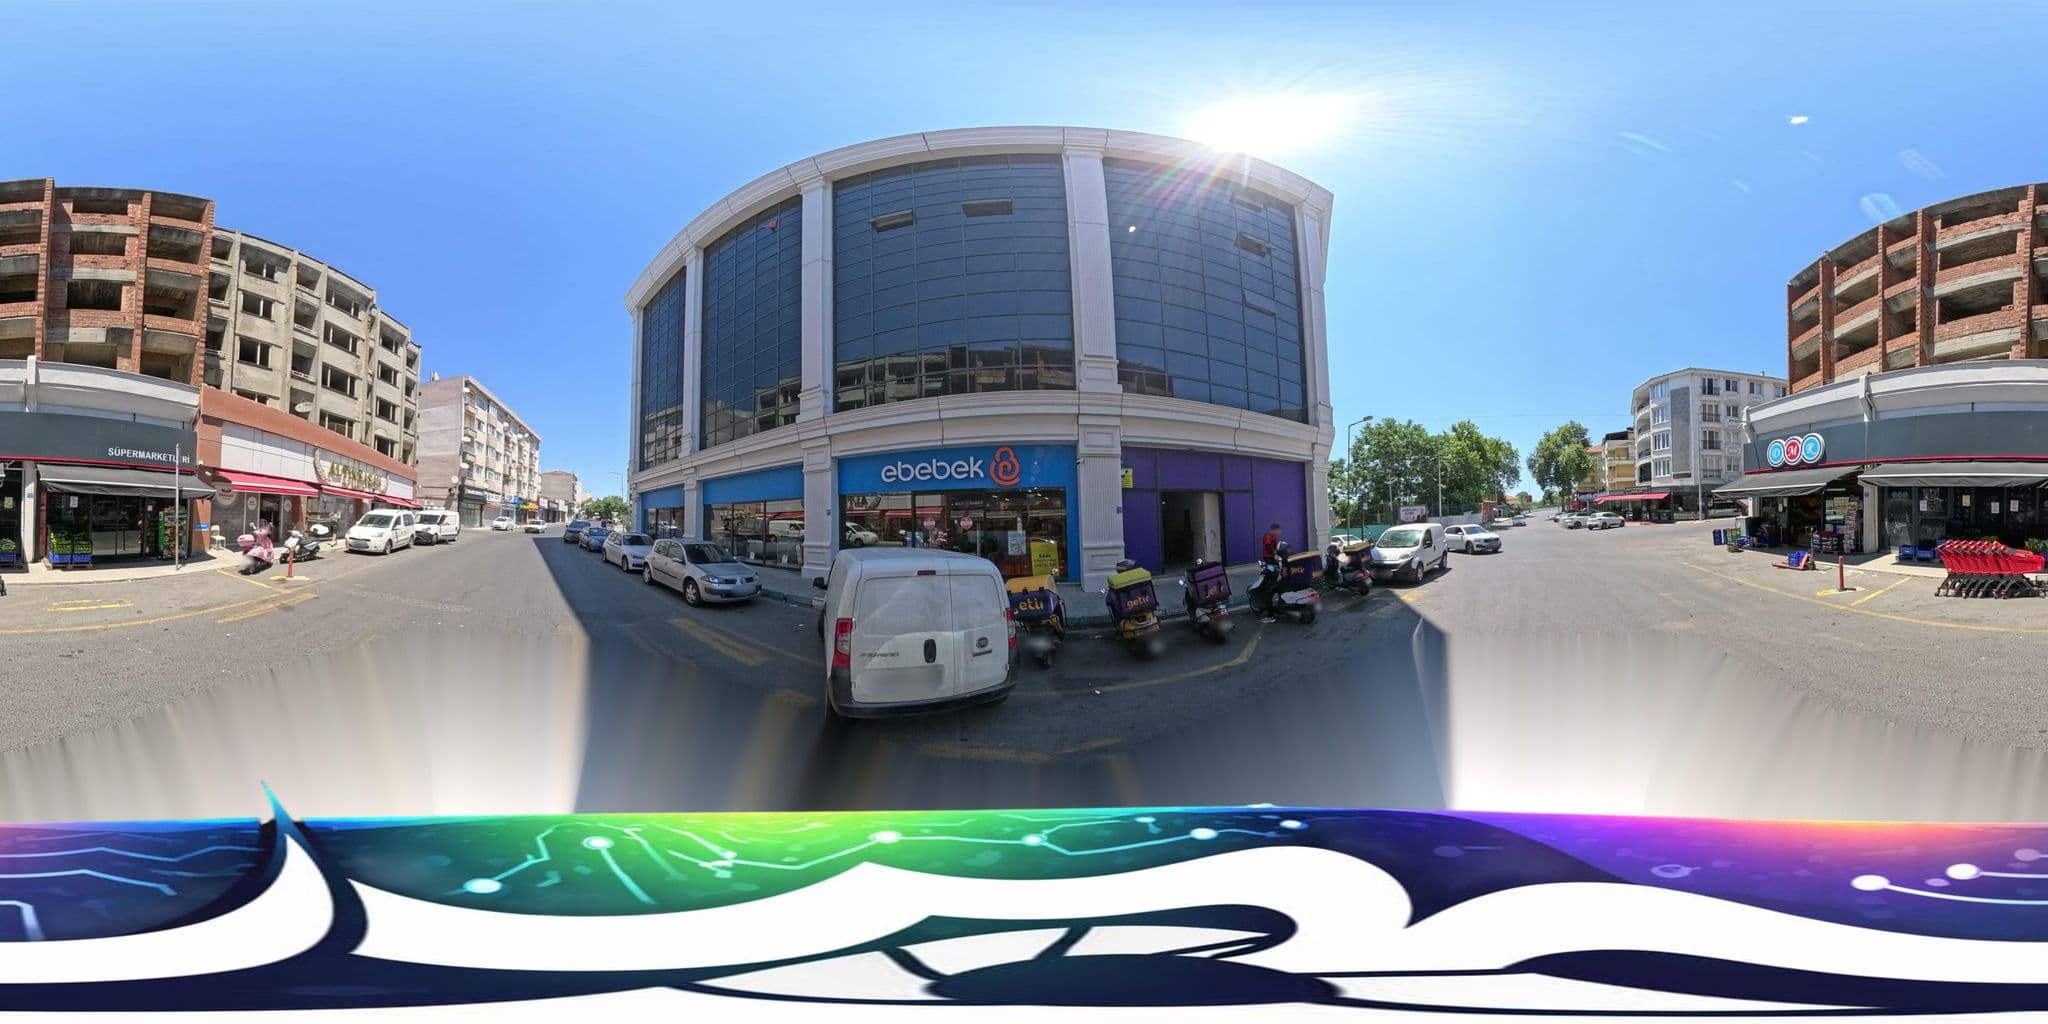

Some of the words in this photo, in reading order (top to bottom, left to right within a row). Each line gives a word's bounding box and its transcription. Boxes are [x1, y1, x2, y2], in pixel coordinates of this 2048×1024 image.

[108, 446, 190, 464] SÜPERMARKETLRİ
[881, 456, 985, 483] ebebek
[1127, 595, 1149, 610] getir
